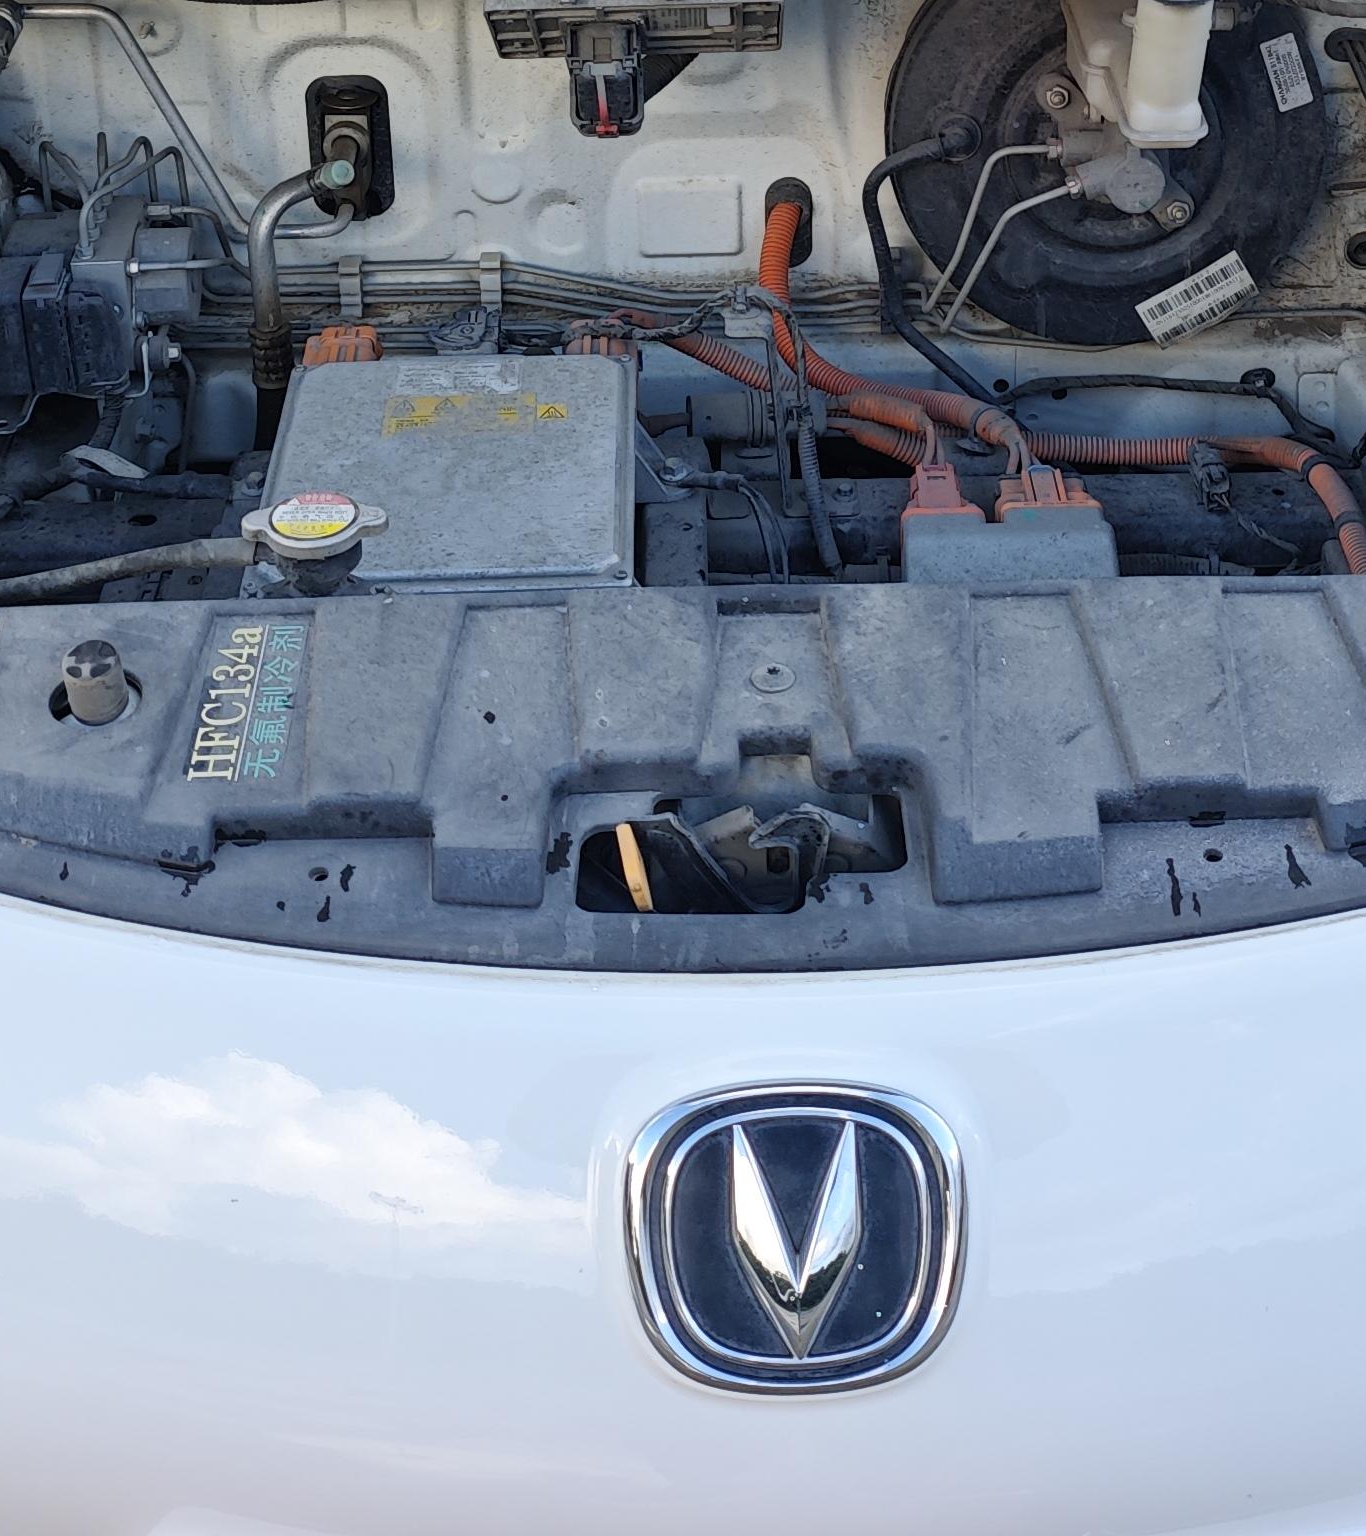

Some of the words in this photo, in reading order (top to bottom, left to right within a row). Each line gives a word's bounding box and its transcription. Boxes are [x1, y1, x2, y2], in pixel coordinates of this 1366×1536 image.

[187, 624, 264, 782] HFC134a
[243, 624, 305, 779] 无氟制冷剂
